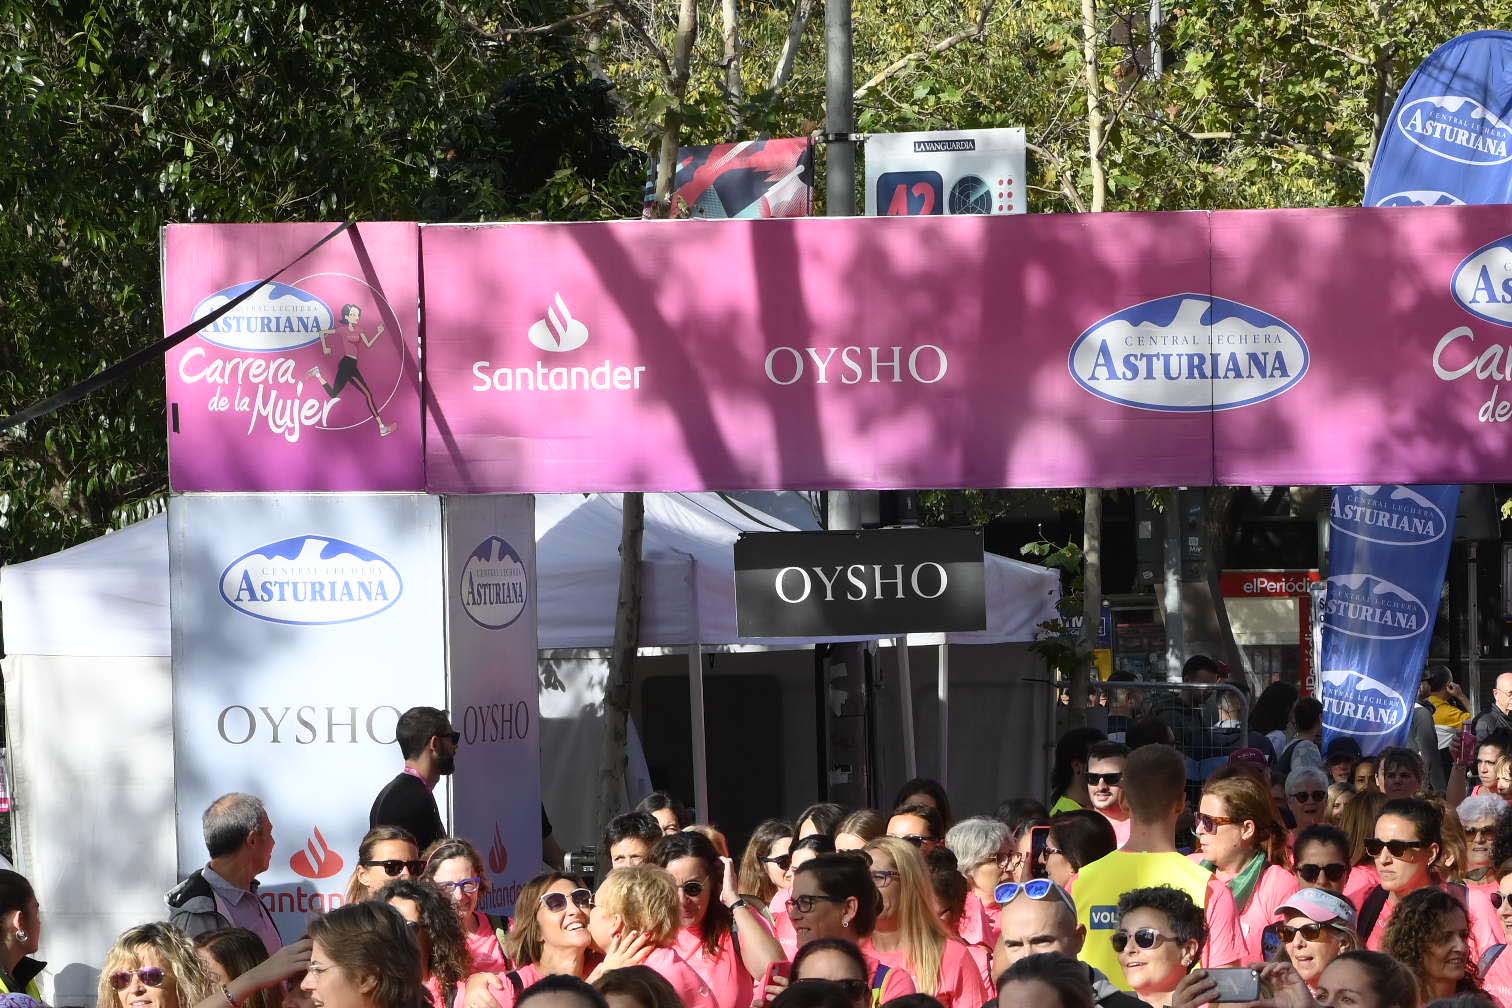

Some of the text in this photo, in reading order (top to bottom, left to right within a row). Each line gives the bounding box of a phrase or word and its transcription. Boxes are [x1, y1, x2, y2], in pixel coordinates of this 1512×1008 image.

[1405, 109, 1509, 159] ASTURIANA
[1124, 333, 1283, 346] CENTRAL LECHERA
[178, 346, 296, 384] Carrera
[472, 358, 646, 392] Santander
[764, 344, 949, 386] OYSHO
[1087, 338, 1290, 383] ASTURIANA
[207, 381, 342, 443] de la Mujer
[1477, 384, 1512, 423] de
[1330, 493, 1436, 537] ASTURIANA
[233, 568, 390, 603] ASTURIANA
[465, 572, 525, 607] ASTURIANA
[774, 561, 950, 604] OYSHO
[1324, 598, 1419, 631] STURIANA
[216, 704, 402, 745] OYSHO
[463, 701, 530, 745] OYSHO
[1323, 697, 1399, 726] TURIANA
[260, 886, 346, 913] antan
[1091, 911, 1119, 925] VOL
